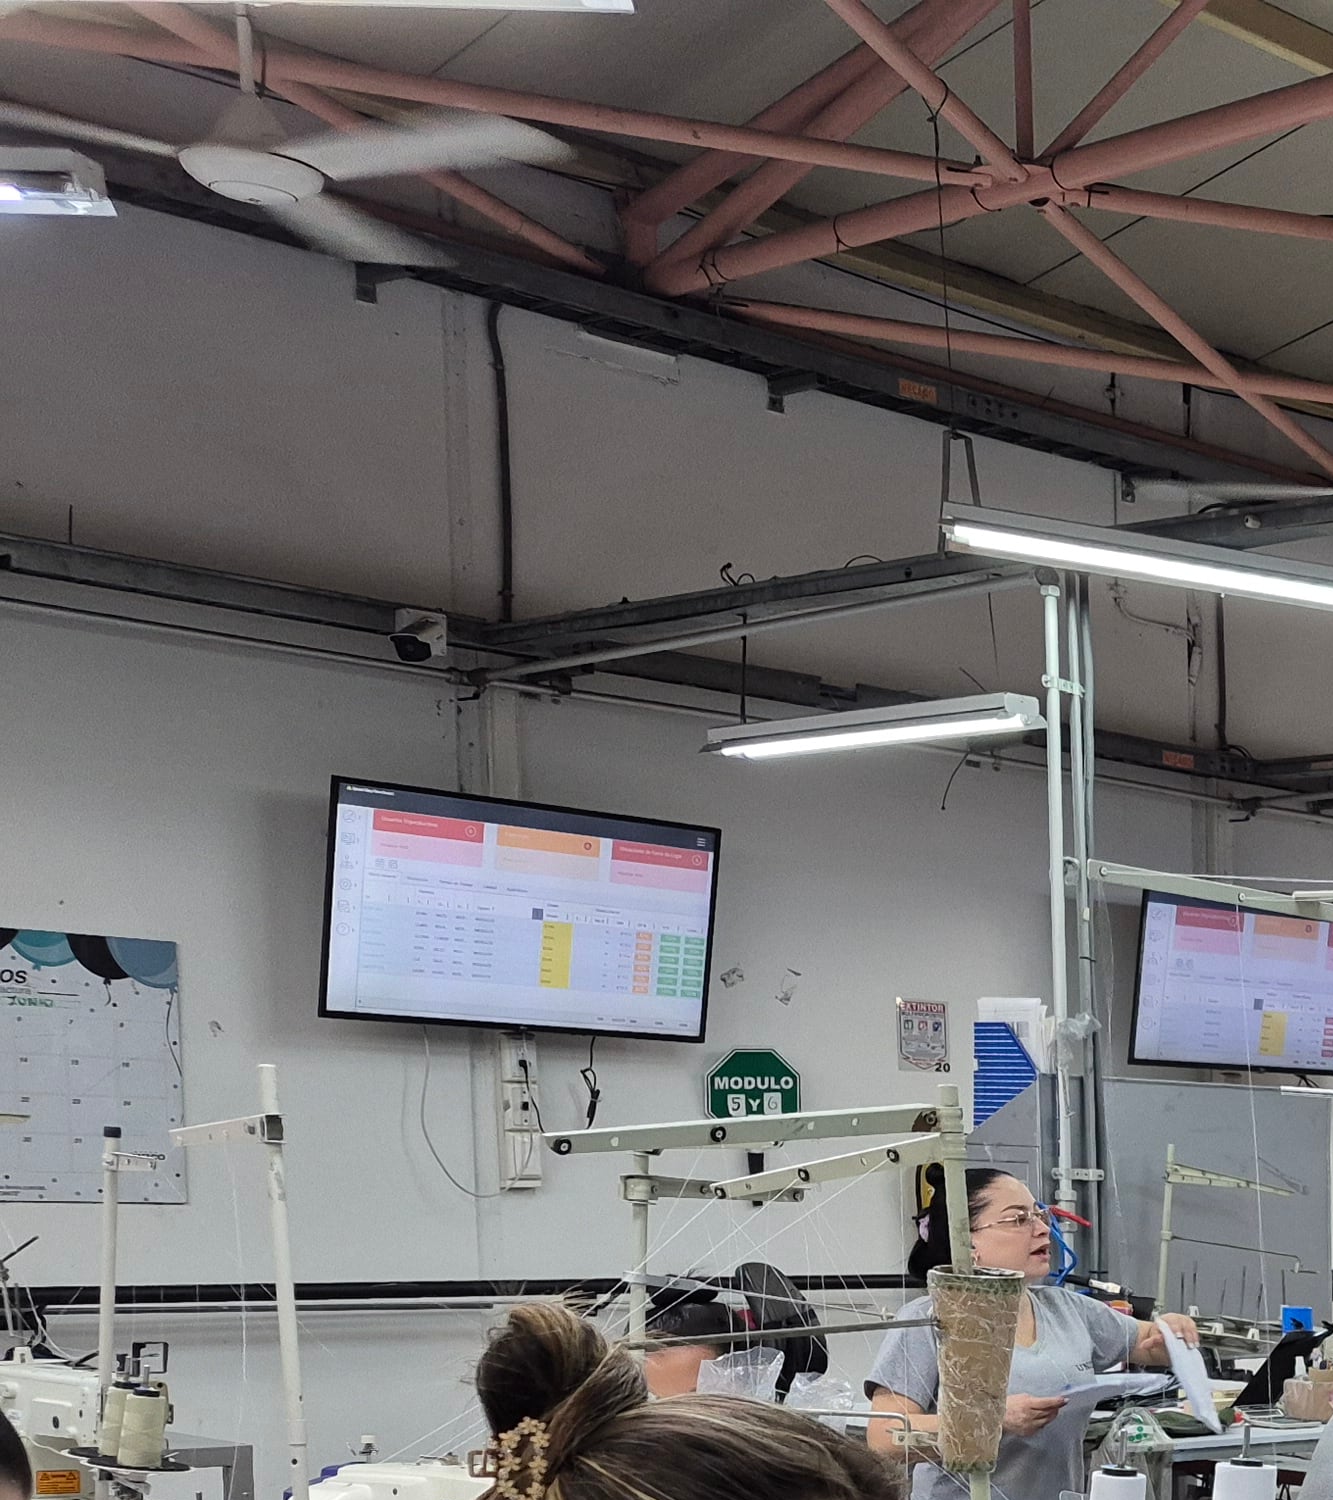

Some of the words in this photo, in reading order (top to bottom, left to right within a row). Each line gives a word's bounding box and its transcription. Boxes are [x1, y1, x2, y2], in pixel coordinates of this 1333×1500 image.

[901, 1002, 944, 1013] EXTINTOR
[935, 1063, 951, 1073] 20
[714, 1076, 794, 1091] MODULO
[731, 1096, 741, 1112] 5
[748, 1098, 761, 1112] Y
[766, 1096, 778, 1111] 6
